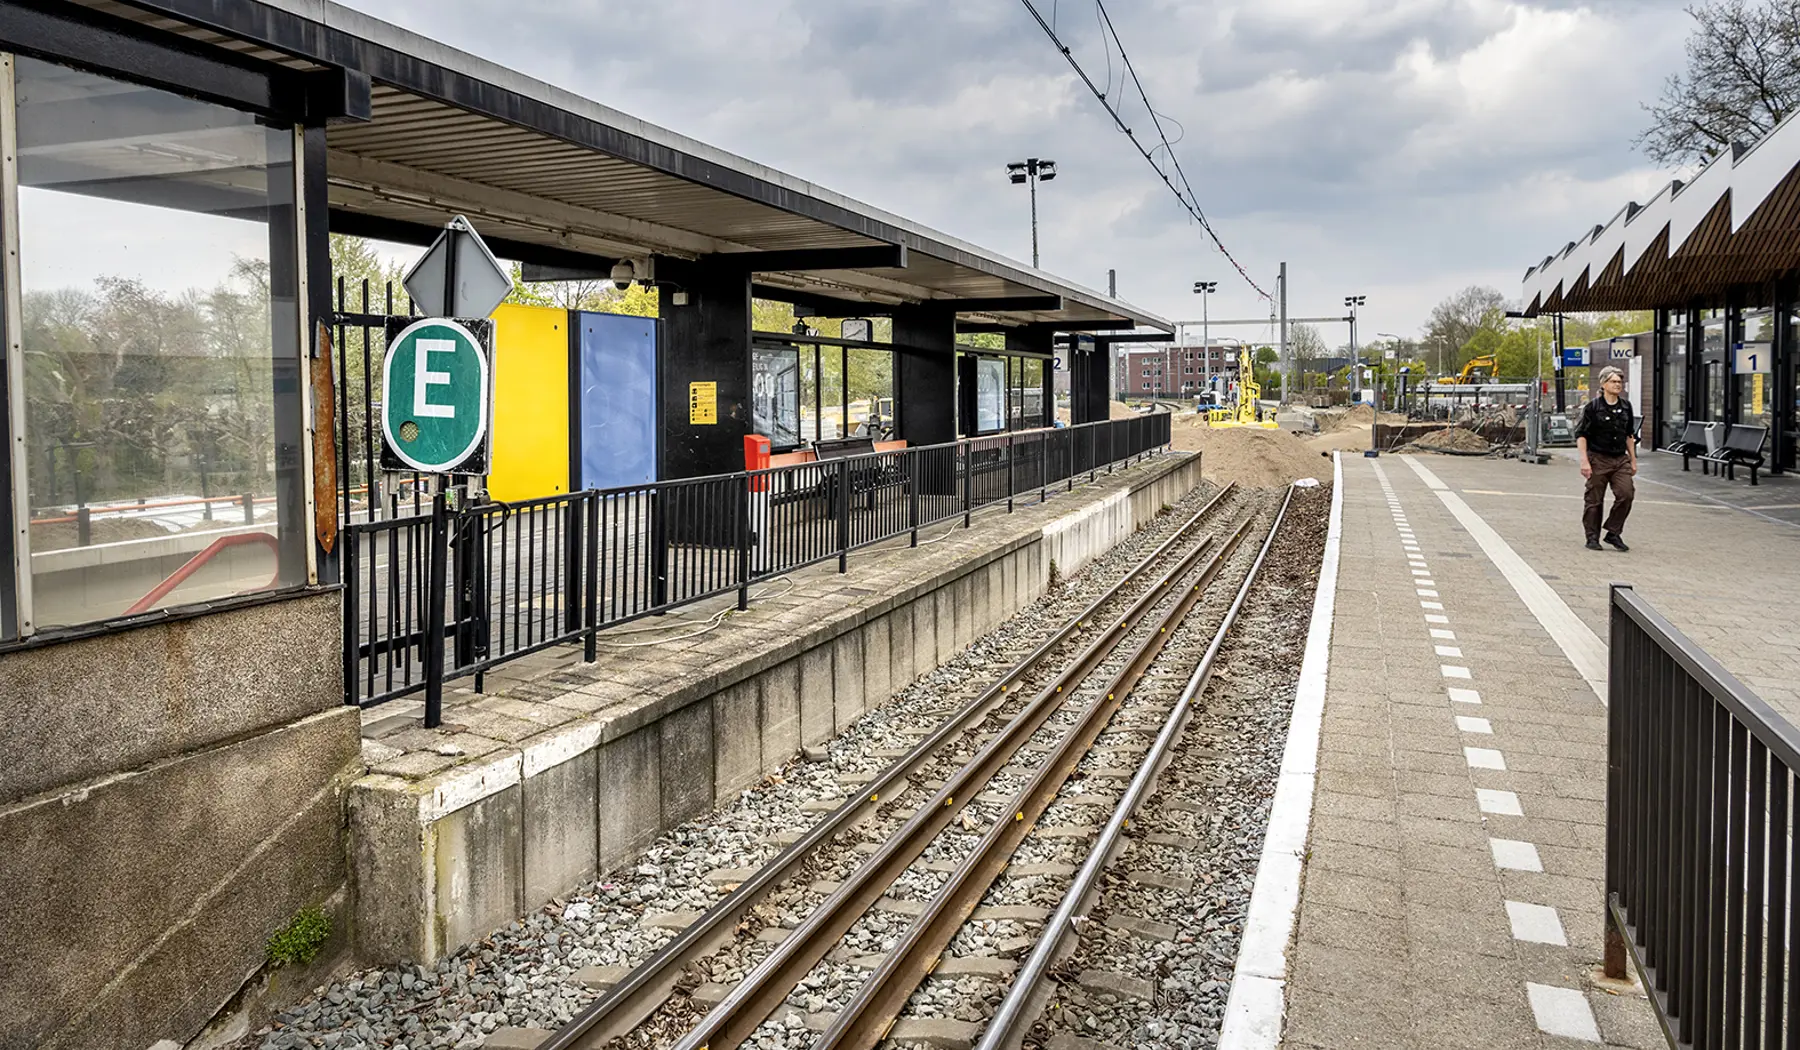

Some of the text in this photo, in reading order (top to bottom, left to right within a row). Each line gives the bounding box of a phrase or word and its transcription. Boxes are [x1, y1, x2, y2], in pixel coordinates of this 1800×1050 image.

[1613, 349, 1632, 358] WC
[1053, 357, 1062, 370] 2
[1748, 354, 1757, 371] 1
[414, 338, 456, 419] E
